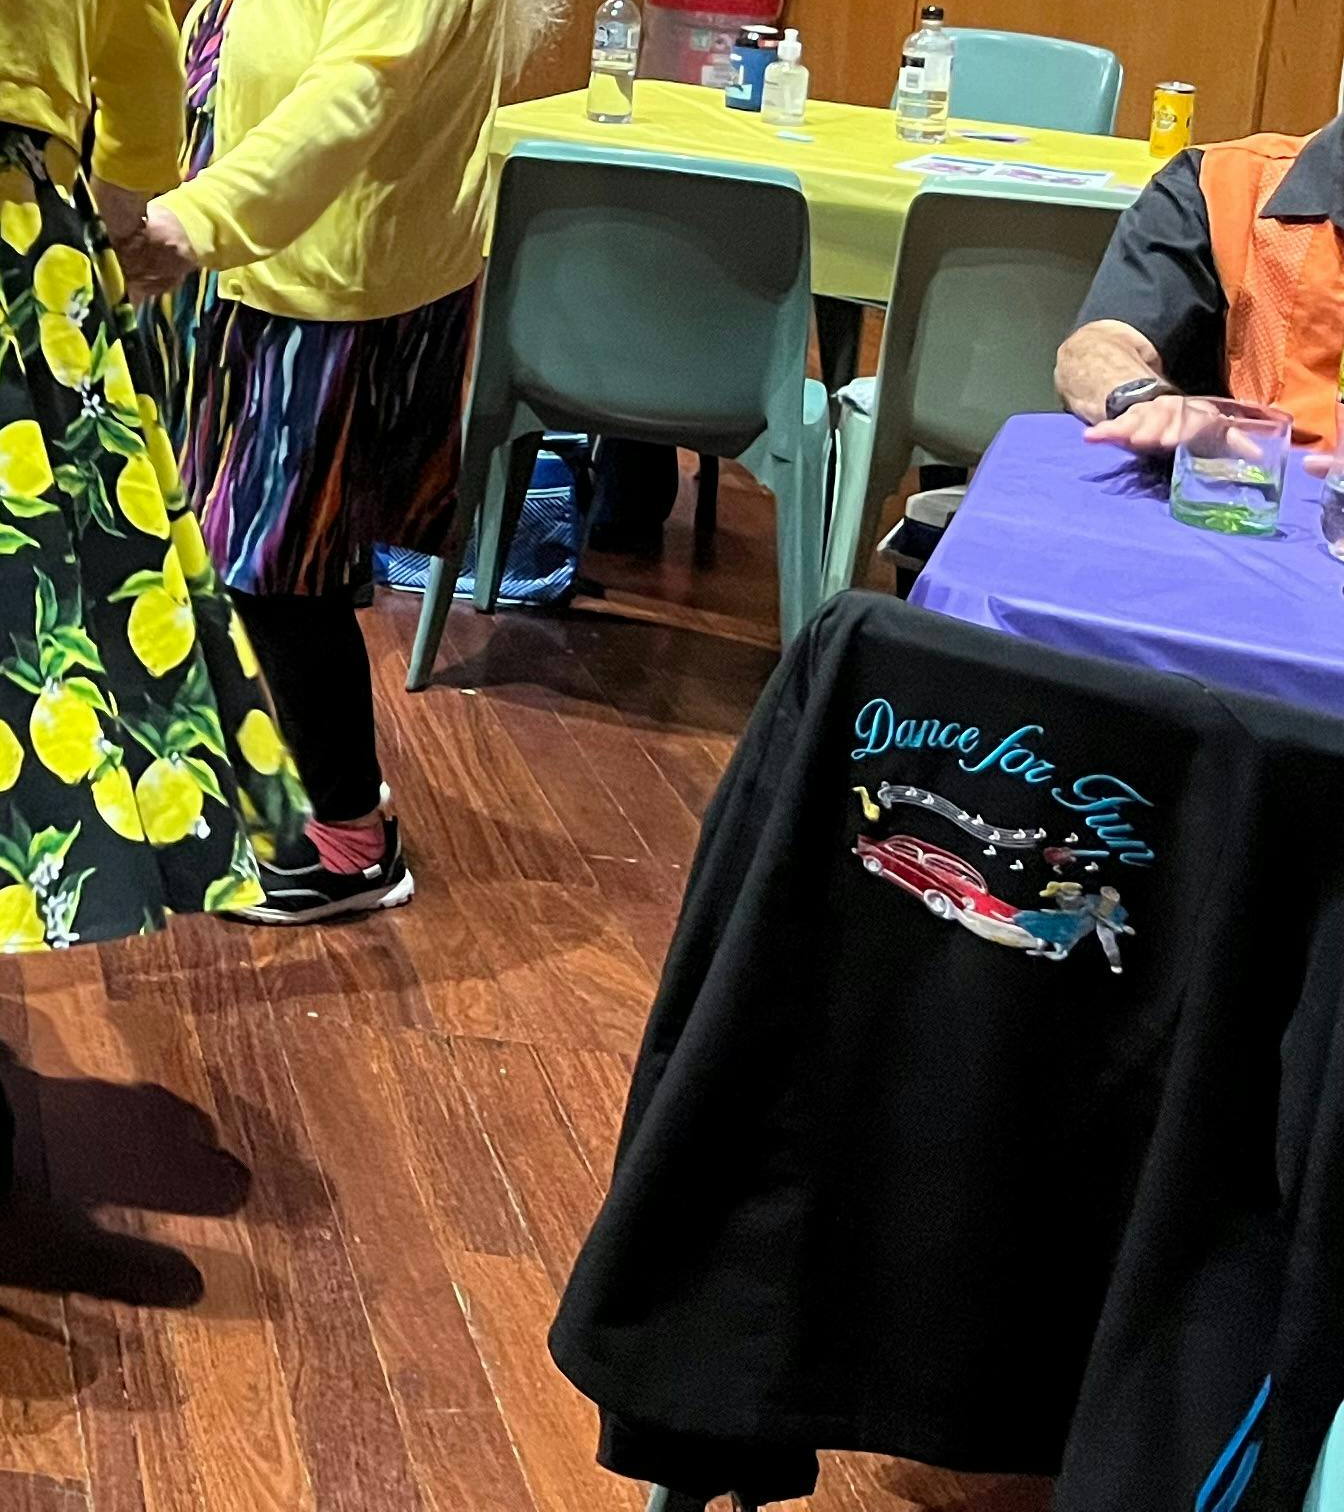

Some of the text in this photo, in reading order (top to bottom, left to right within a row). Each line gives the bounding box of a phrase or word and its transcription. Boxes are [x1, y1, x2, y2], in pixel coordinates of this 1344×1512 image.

[851, 698, 1056, 783] Dance for
[1051, 774, 1156, 867] Fun
